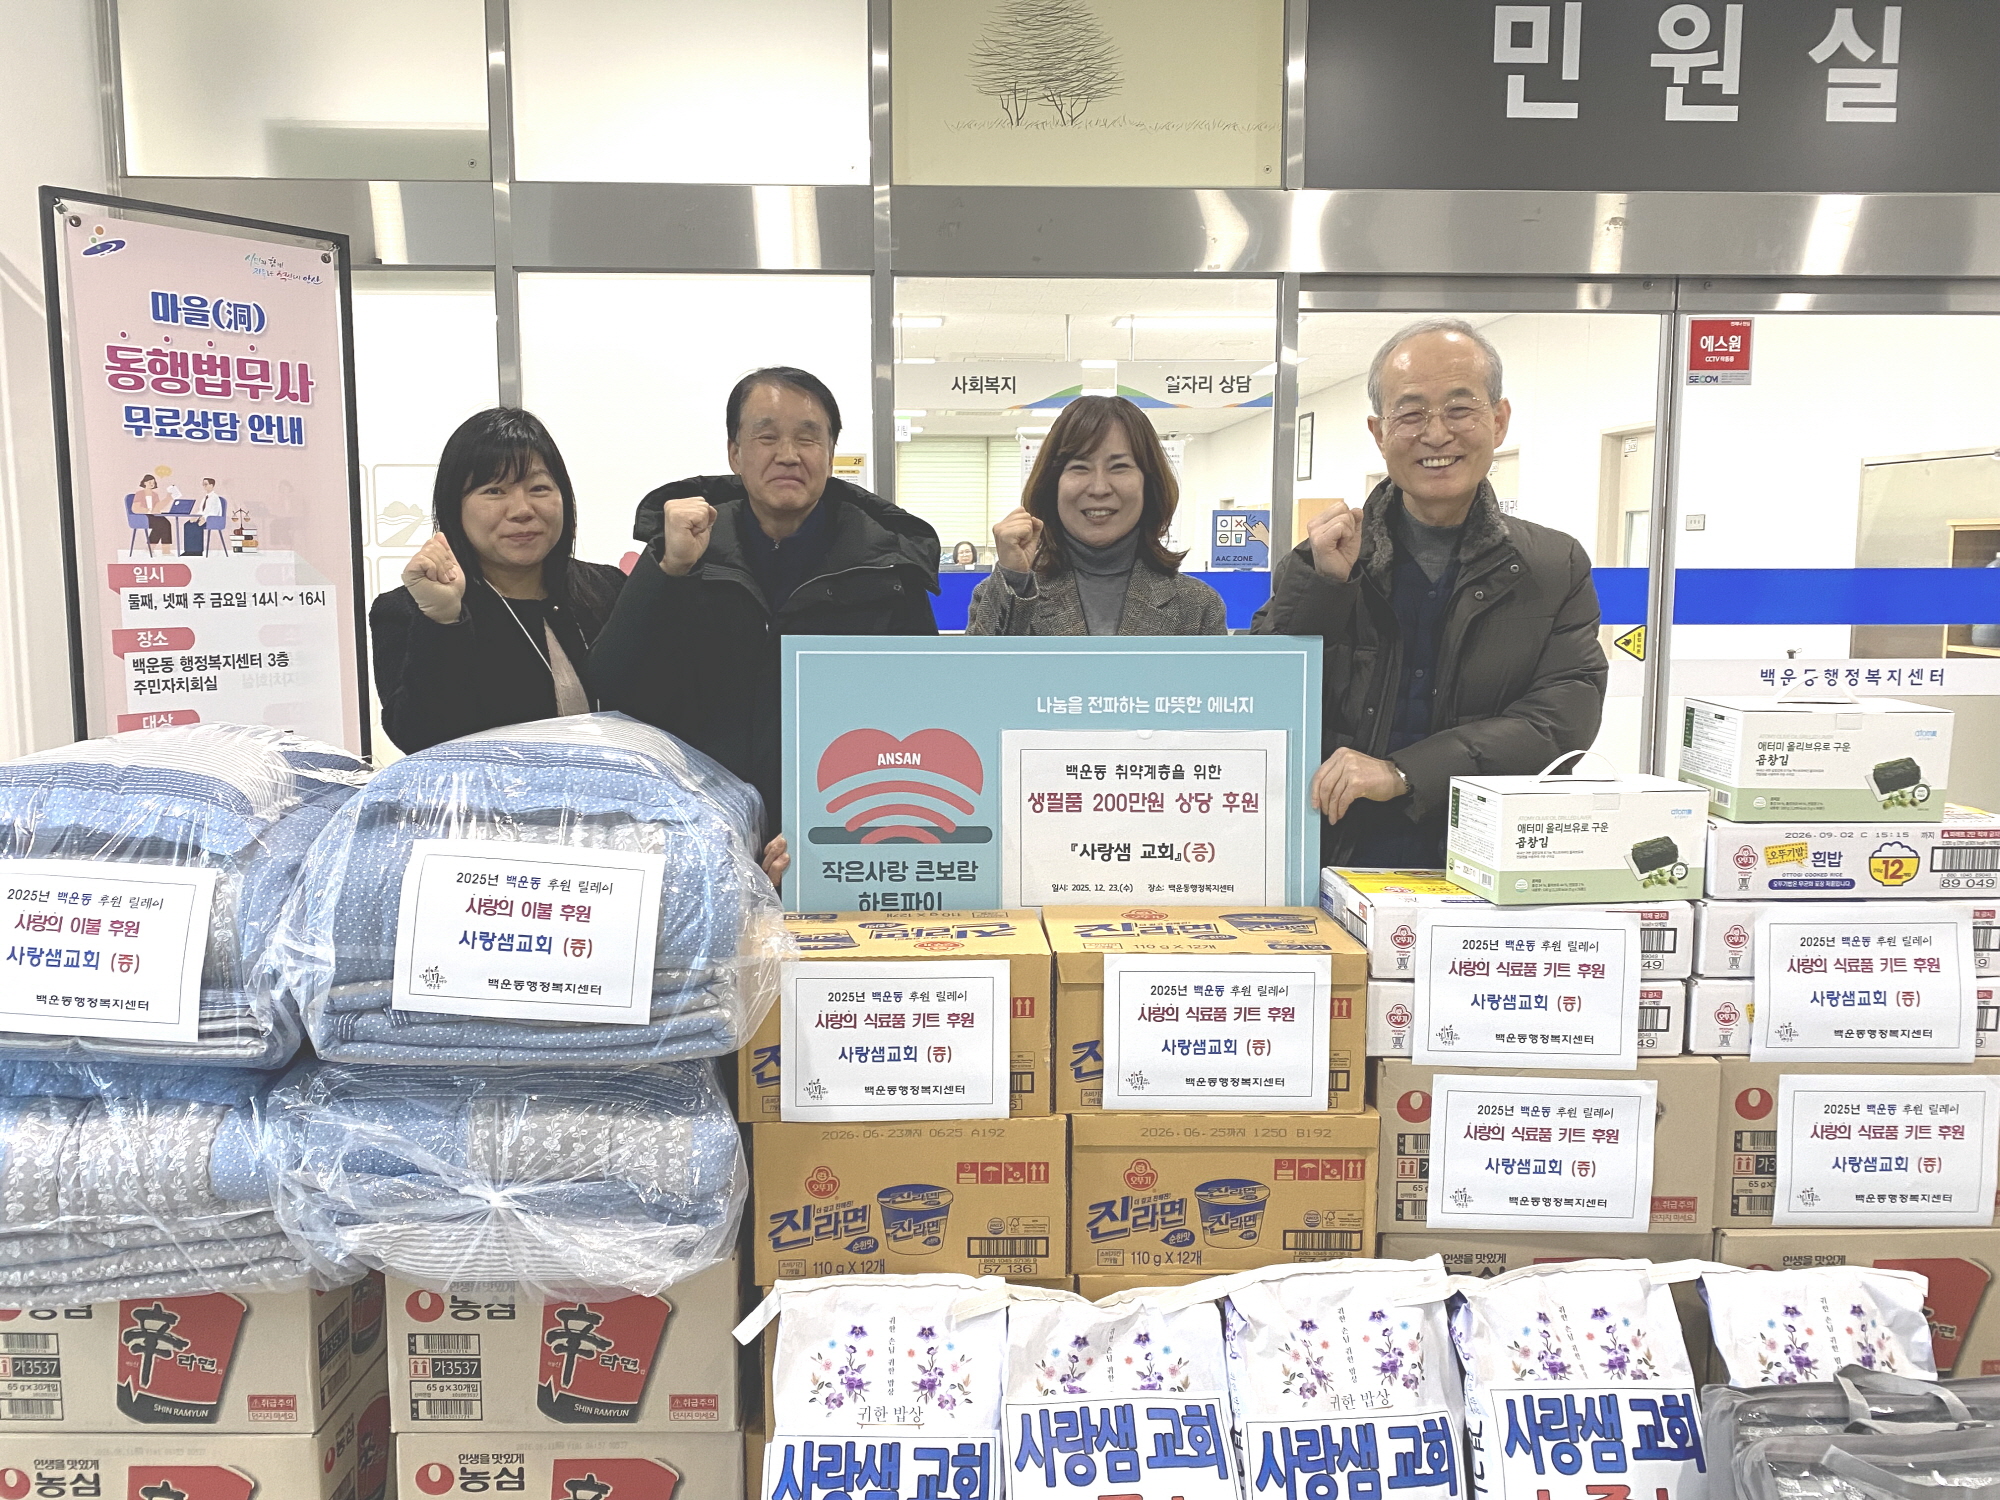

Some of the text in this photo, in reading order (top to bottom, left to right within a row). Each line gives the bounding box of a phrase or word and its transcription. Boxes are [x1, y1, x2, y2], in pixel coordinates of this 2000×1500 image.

[1494, 1, 1902, 122] 민원실
[151, 291, 266, 333] 마을(洞)
[1700, 335, 1741, 352] 에스원
[105, 344, 314, 403] 동행법무사
[1689, 375, 1719, 383] SECOM
[951, 375, 1017, 395] 사회복지
[1165, 374, 1252, 394] 일자리 상담
[124, 406, 303, 445] 무료상담 안내
[133, 567, 165, 584] 일시
[128, 593, 157, 610] 둘째,
[163, 593, 188, 609] 넷째
[193, 594, 205, 608] 주
[210, 592, 247, 609] 금요일
[252, 592, 278, 606] 14시
[299, 591, 325, 606] 16시
[137, 632, 169, 648] 장소
[133, 652, 289, 674] 백운동 행정복지센터 3층
[134, 676, 217, 695] 주민자치회실
[1037, 695, 1254, 715] 나눔을 전파하는 따뜻한 에너지
[877, 752, 921, 767] ANSAN
[1065, 764, 1222, 781] 백운동 취약계층을 위한
[1028, 791, 1259, 814] 생필품 200만원 상당 후원
[1518, 822, 1609, 833] 애터미 올리브유로 구운
[1516, 836, 1549, 849] 곱창김
[1070, 842, 1131, 862] 『사랑샘
[1767, 846, 1805, 860] 오뚜기밥
[1811, 850, 1843, 868] 흰밥
[822, 859, 979, 884] 작은사랑 큰보람
[1882, 859, 1904, 879] 12
[457, 872, 613, 895] 2025년 백운동 후원 릴레이
[1051, 883, 1234, 894] 일시: 2025. 12. 23.(수) 장소: 백운동행정복지센터
[1941, 879, 1995, 888] 89 049
[7, 888, 163, 911] 2025년 백운동 후원 릴레이
[858, 891, 943, 911] 하트파이
[465, 897, 592, 923] 사랑의 이불 후원
[15, 913, 139, 938] 사랑의 이불 후원
[459, 929, 593, 959] 사랑샘교회 (증)
[1800, 935, 1932, 948] 2025년 백운동 후원 릴레이
[6, 946, 140, 975] 사랑샘교회 (증)
[1787, 956, 1941, 974] 사랑의 식료품 키트 후원
[488, 978, 601, 995] 백운동행정복지센터
[36, 993, 149, 1011] 백운동행정복지센터
[828, 990, 968, 1002] 2025년 백운동 후원 릴레이
[1810, 990, 1920, 1007] 사랑샘교회 (증)
[815, 1012, 974, 1029] 사랑의 식료품 키트 후원
[1834, 1029, 1933, 1039] 백운동행정복지센터
[838, 1045, 952, 1063] 사랑샘교회 (증)
[864, 1085, 966, 1096] 백운동행정복지센터
[1477, 1104, 1614, 1120] 2025년 백운동 후원 릴레이
[929, 1128, 963, 1138] 0625
[971, 1128, 1005, 1138] A192
[1254, 1127, 1287, 1138] 1250
[1296, 1128, 1332, 1138] B192
[1464, 1124, 1619, 1145] 사랑의 식료품 키트 후원
[1485, 1157, 1596, 1178] 사랑샘교회 (증)
[1509, 1196, 1607, 1209] 백운동행정복지센터
[768, 1203, 871, 1252] 진라면
[1086, 1195, 1188, 1244] 진라면
[852, 1239, 875, 1252] 순한맛
[1168, 1232, 1191, 1245] 순한맛
[1131, 1252, 1149, 1265] 110
[1153, 1254, 1162, 1266] g
[1177, 1250, 1201, 1266] 12개
[544, 1303, 614, 1388] 辛
[434, 1360, 478, 1375] 가3537
[600, 1354, 641, 1373] 라면
[574, 1403, 629, 1418] SHIN RAMYUN
[683, 1397, 716, 1408] 취급주의
[858, 1405, 924, 1423] 귀한 밥상
[1505, 1392, 1708, 1476] 사랑샘 교회
[1015, 1403, 1229, 1489] 사랑샘 교회
[458, 1453, 525, 1465] 인생을 맛있게
[1255, 1417, 1459, 1500] 사랑샘 교회
[458, 1467, 525, 1492] 농심
[771, 1441, 990, 1500] 사랑샘 교회
